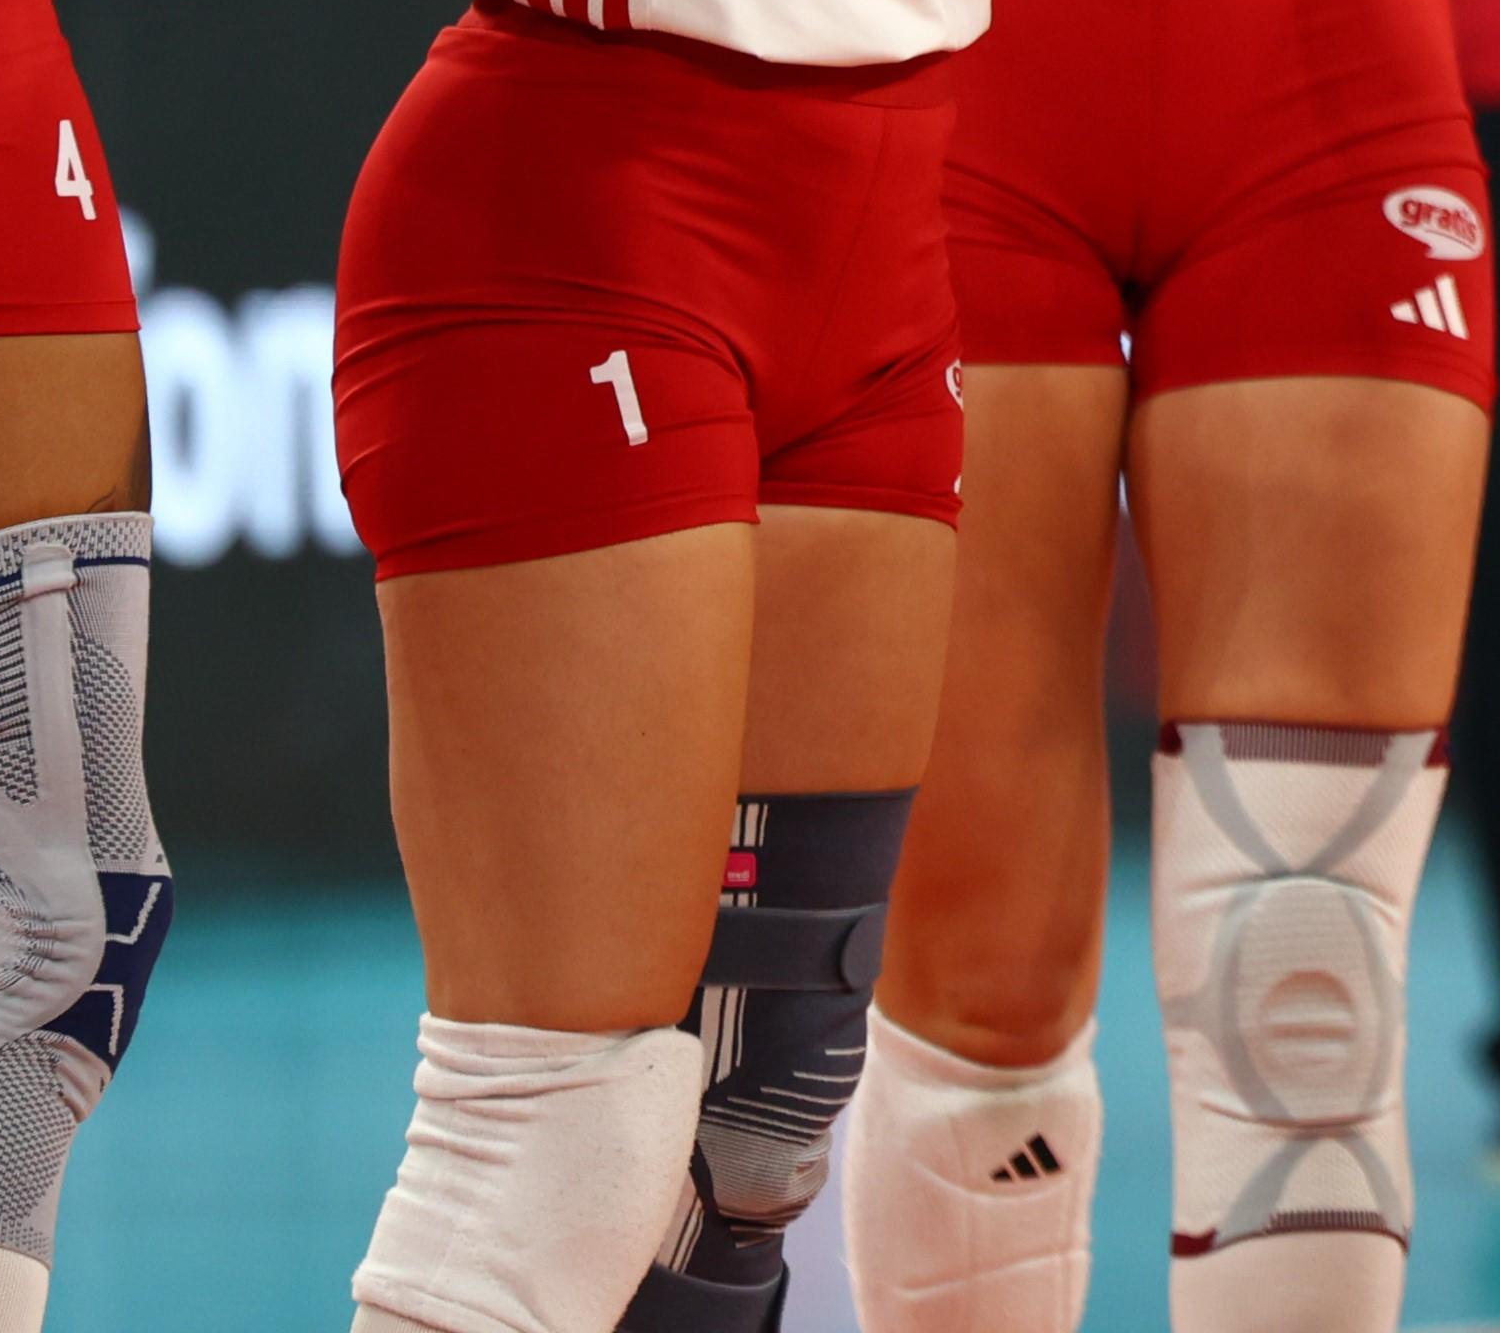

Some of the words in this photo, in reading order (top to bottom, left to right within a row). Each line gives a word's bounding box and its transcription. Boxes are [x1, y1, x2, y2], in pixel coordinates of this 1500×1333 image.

[54, 118, 98, 222] 4
[1400, 198, 1478, 247] gratis
[589, 349, 648, 446] 1
